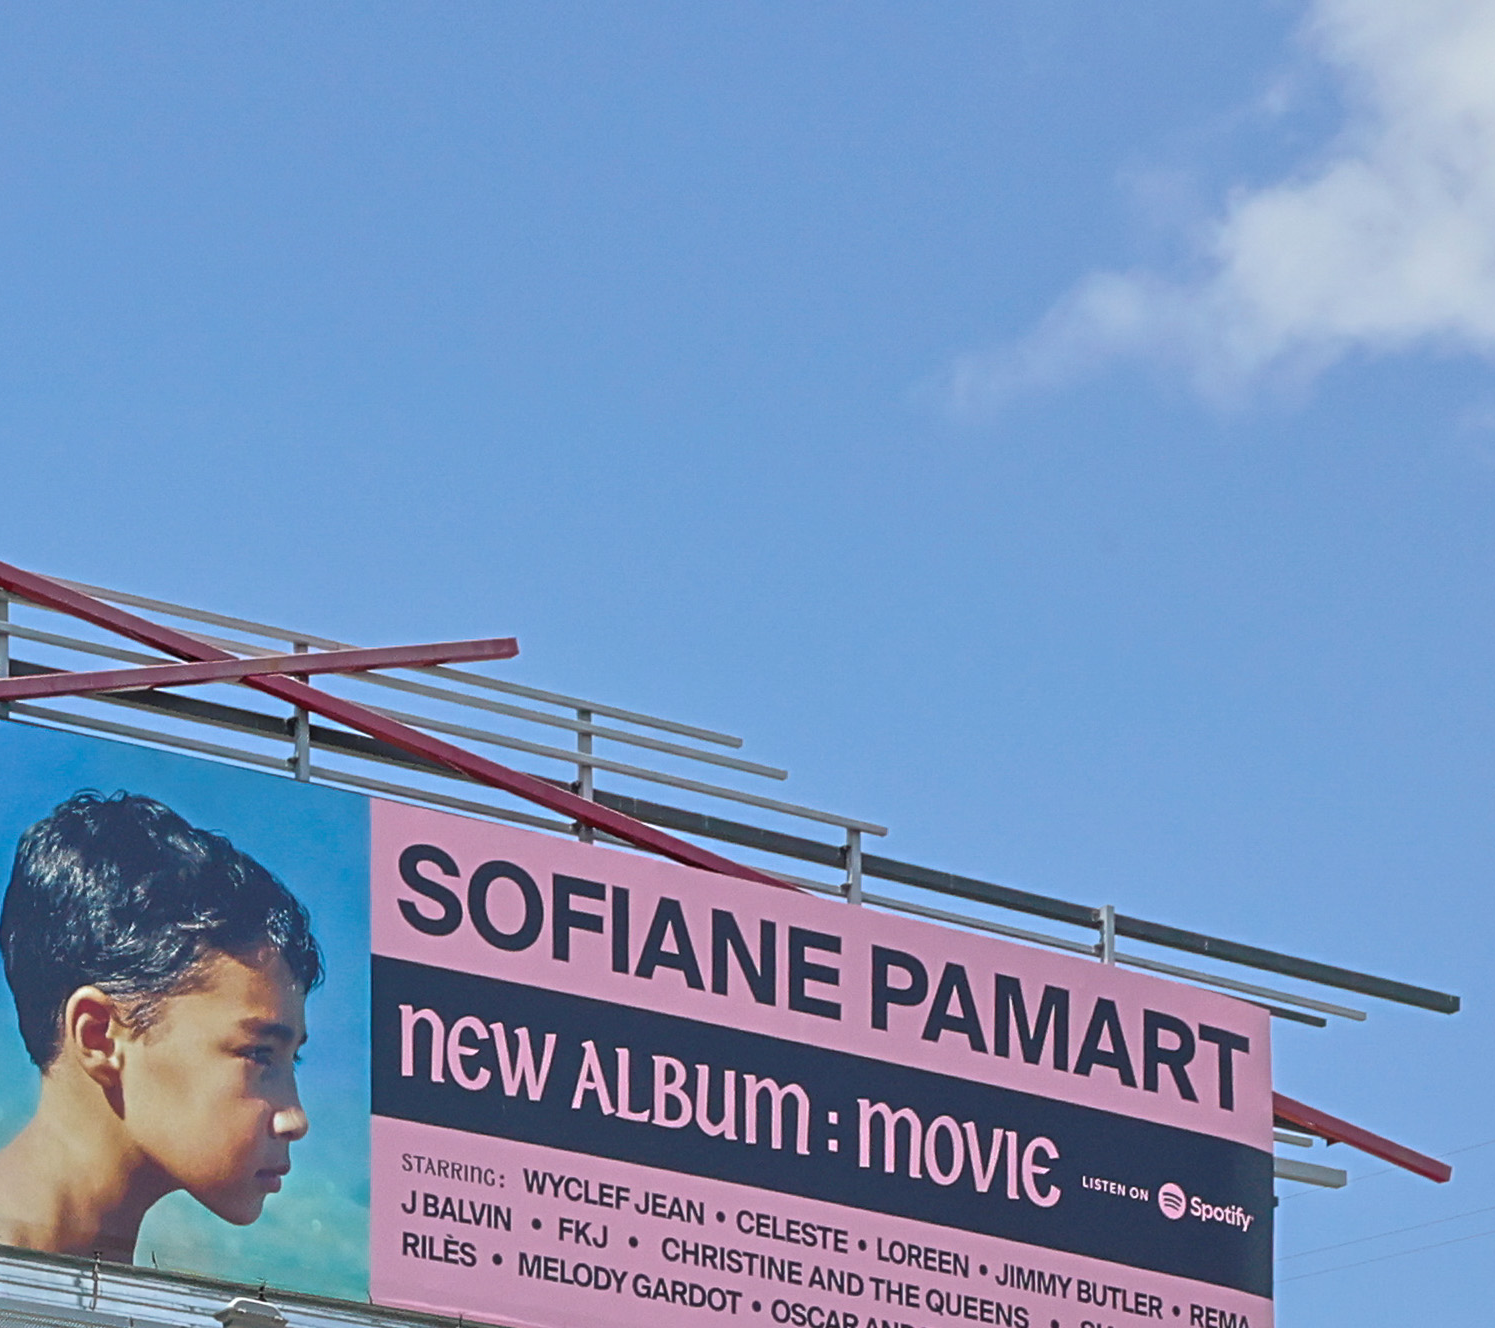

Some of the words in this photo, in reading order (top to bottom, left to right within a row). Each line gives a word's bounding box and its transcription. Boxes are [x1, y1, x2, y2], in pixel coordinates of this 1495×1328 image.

[397, 844, 842, 1021] SOFIANE
[871, 944, 1250, 1112] PAMART
[572, 1040, 810, 1156] ALBUM
[857, 1098, 1061, 1207] MOVIE
[401, 1191, 417, 1215] J
[423, 1193, 512, 1232] BALVIN
[558, 1218, 608, 1249] FKJ
[662, 1237, 803, 1286] CHRISTINE
[808, 1265, 864, 1297] AND
[869, 1277, 920, 1309] THE
[523, 1168, 630, 1210] WYCLEF
[634, 1192, 705, 1225] JEAN
[736, 1210, 848, 1254] CELESTE
[877, 1237, 969, 1279] LOREEN
[995, 1263, 1072, 1300] JIMMY
[1077, 1280, 1163, 1319] BUTLER
[1082, 1176, 1126, 1198] LISTEN
[1128, 1186, 1150, 1202] ON
[1190, 1196, 1254, 1233] Spotify
[402, 1232, 477, 1267] RILÈS
[518, 1252, 628, 1295] MELODY
[632, 1274, 743, 1315] GARDOT
